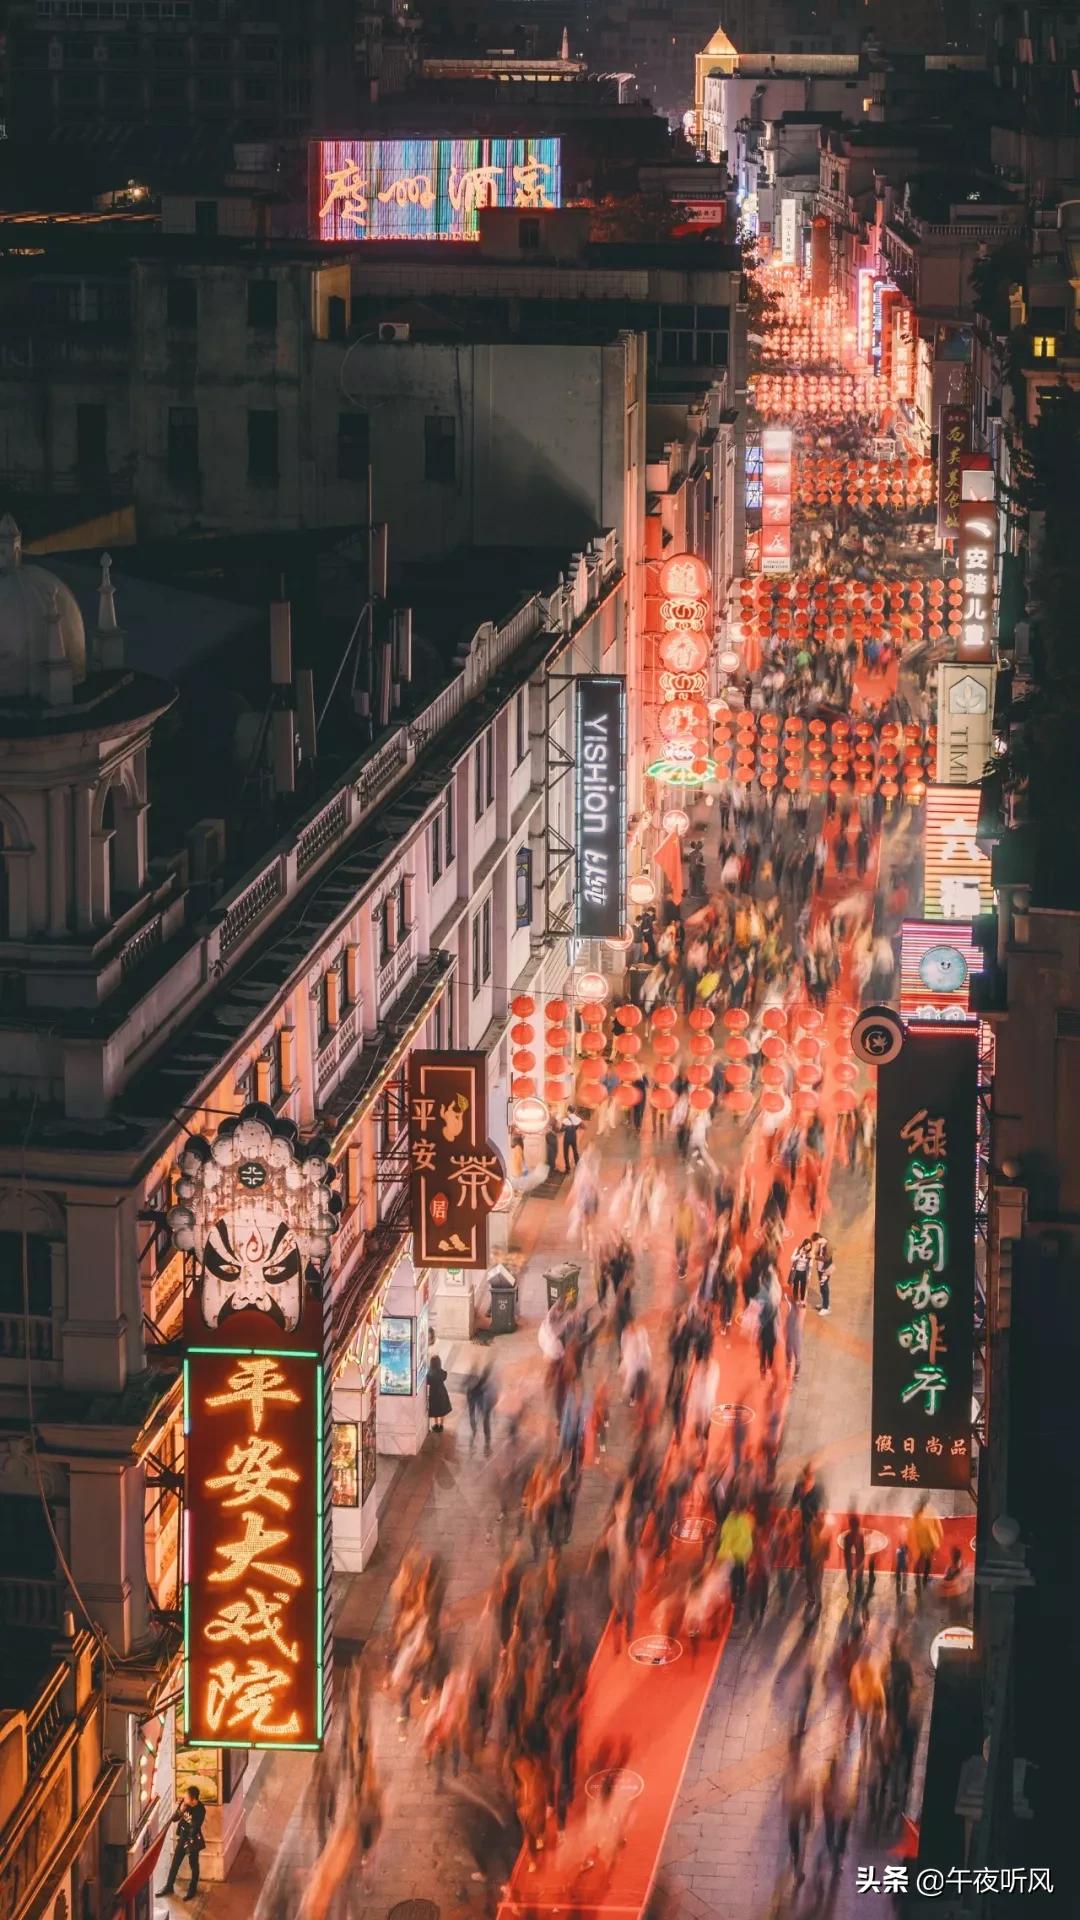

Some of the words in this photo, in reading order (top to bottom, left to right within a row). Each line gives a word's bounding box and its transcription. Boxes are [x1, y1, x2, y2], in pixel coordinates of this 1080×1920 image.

[964, 548, 988, 646] 安踏儿童
[875, 1434, 968, 1456] 假日尚品
[877, 1463, 921, 1482] 二楼
[203, 1357, 304, 1736] 平安大戏院
